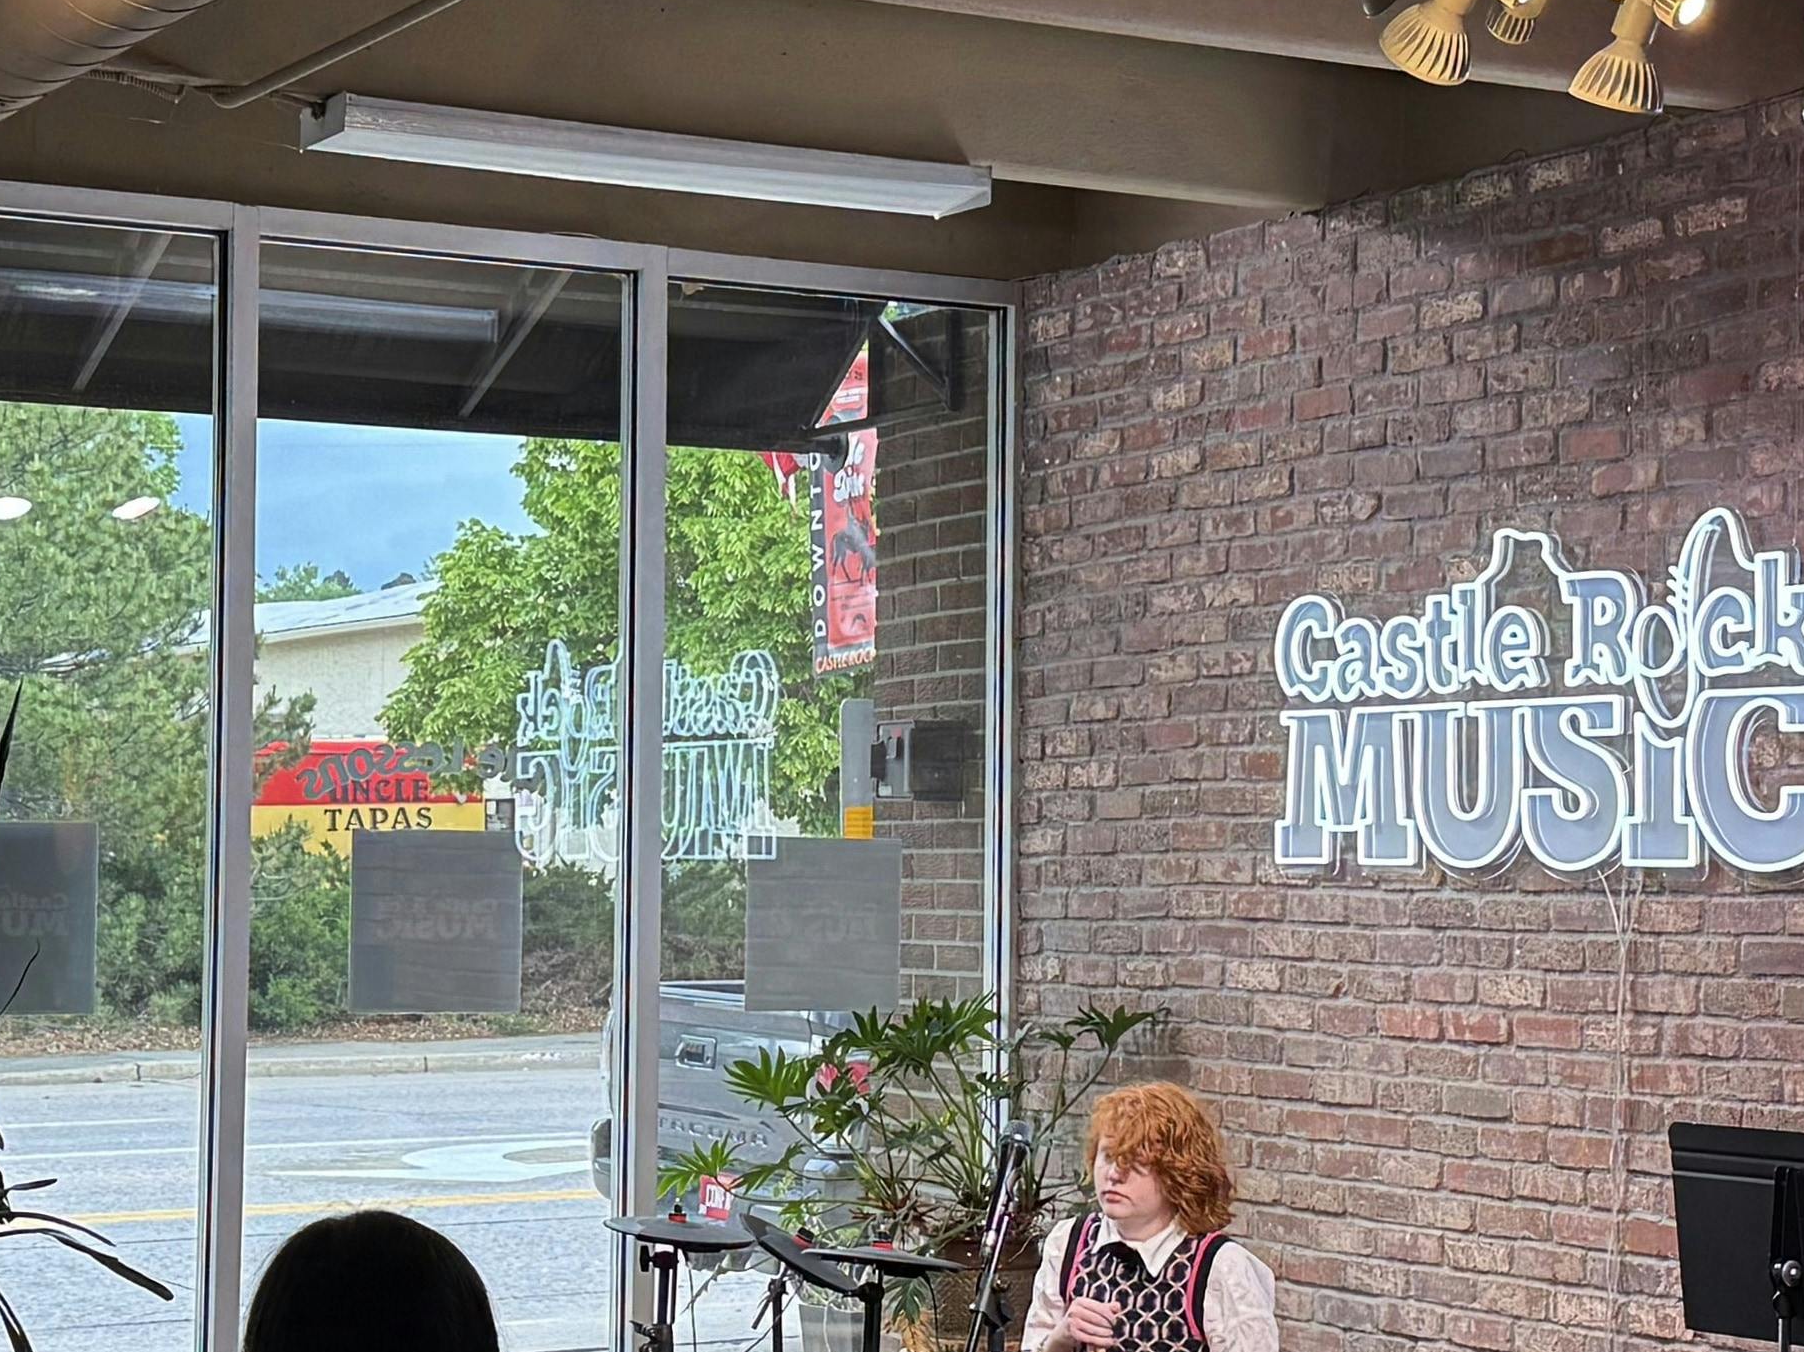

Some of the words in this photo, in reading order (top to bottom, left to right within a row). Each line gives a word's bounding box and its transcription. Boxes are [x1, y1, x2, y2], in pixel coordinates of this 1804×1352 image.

[810, 453, 828, 638] DOWNTO
[1275, 577, 1552, 704] Castle
[329, 779, 430, 803] UNCLE
[324, 807, 433, 832] TAPAS
[660, 1117, 768, 1148] TACOMA
